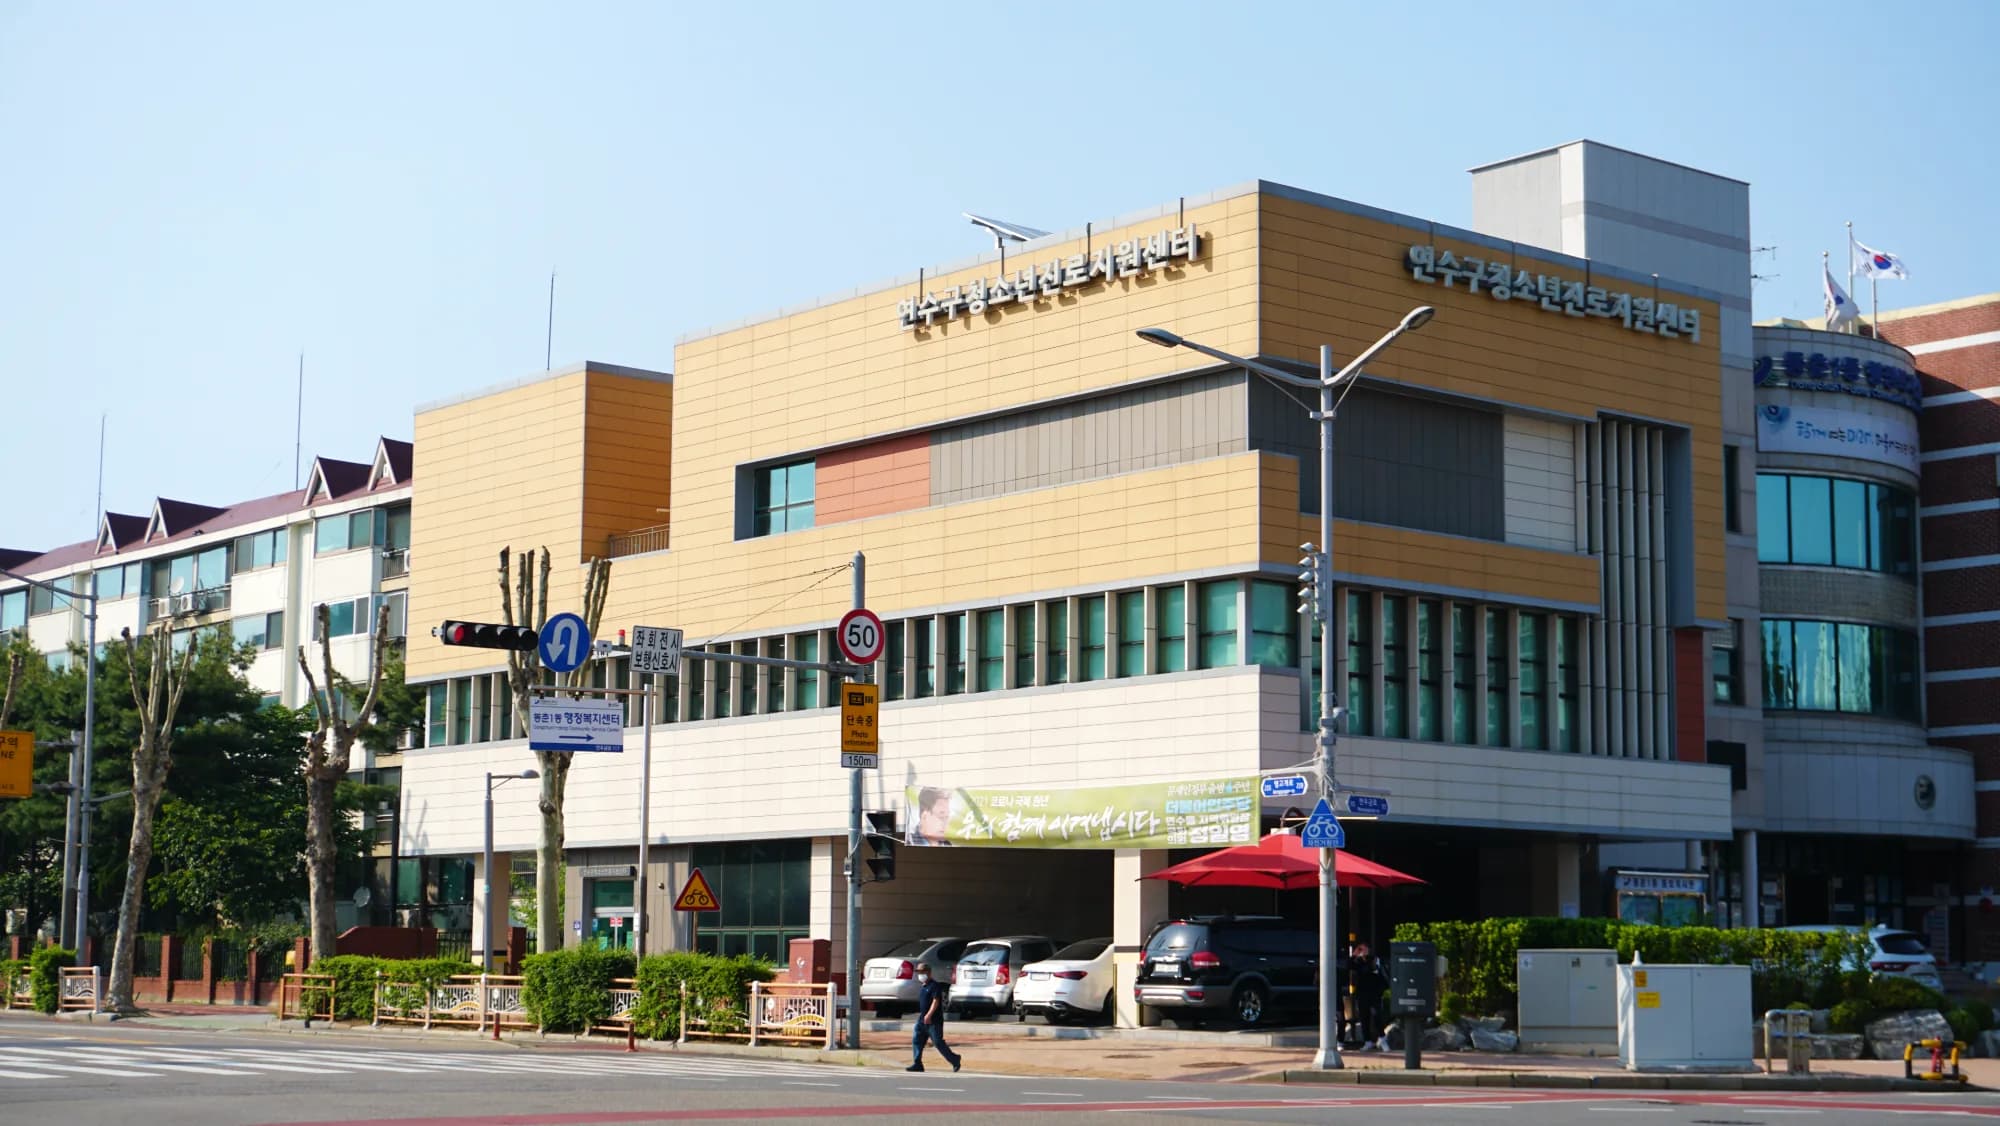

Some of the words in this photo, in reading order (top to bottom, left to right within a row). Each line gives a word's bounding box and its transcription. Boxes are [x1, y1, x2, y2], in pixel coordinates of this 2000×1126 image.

[896, 222, 1199, 331] 연수구청소년진로지원센터
[1407, 245, 1701, 343] 연수구청소년진로지원센터
[848, 623, 875, 648] 50
[634, 650, 678, 672] 보행신호시
[564, 711, 620, 725] 행정복지센터
[846, 715, 873, 727] 단속중
[848, 755, 872, 767] 150m
